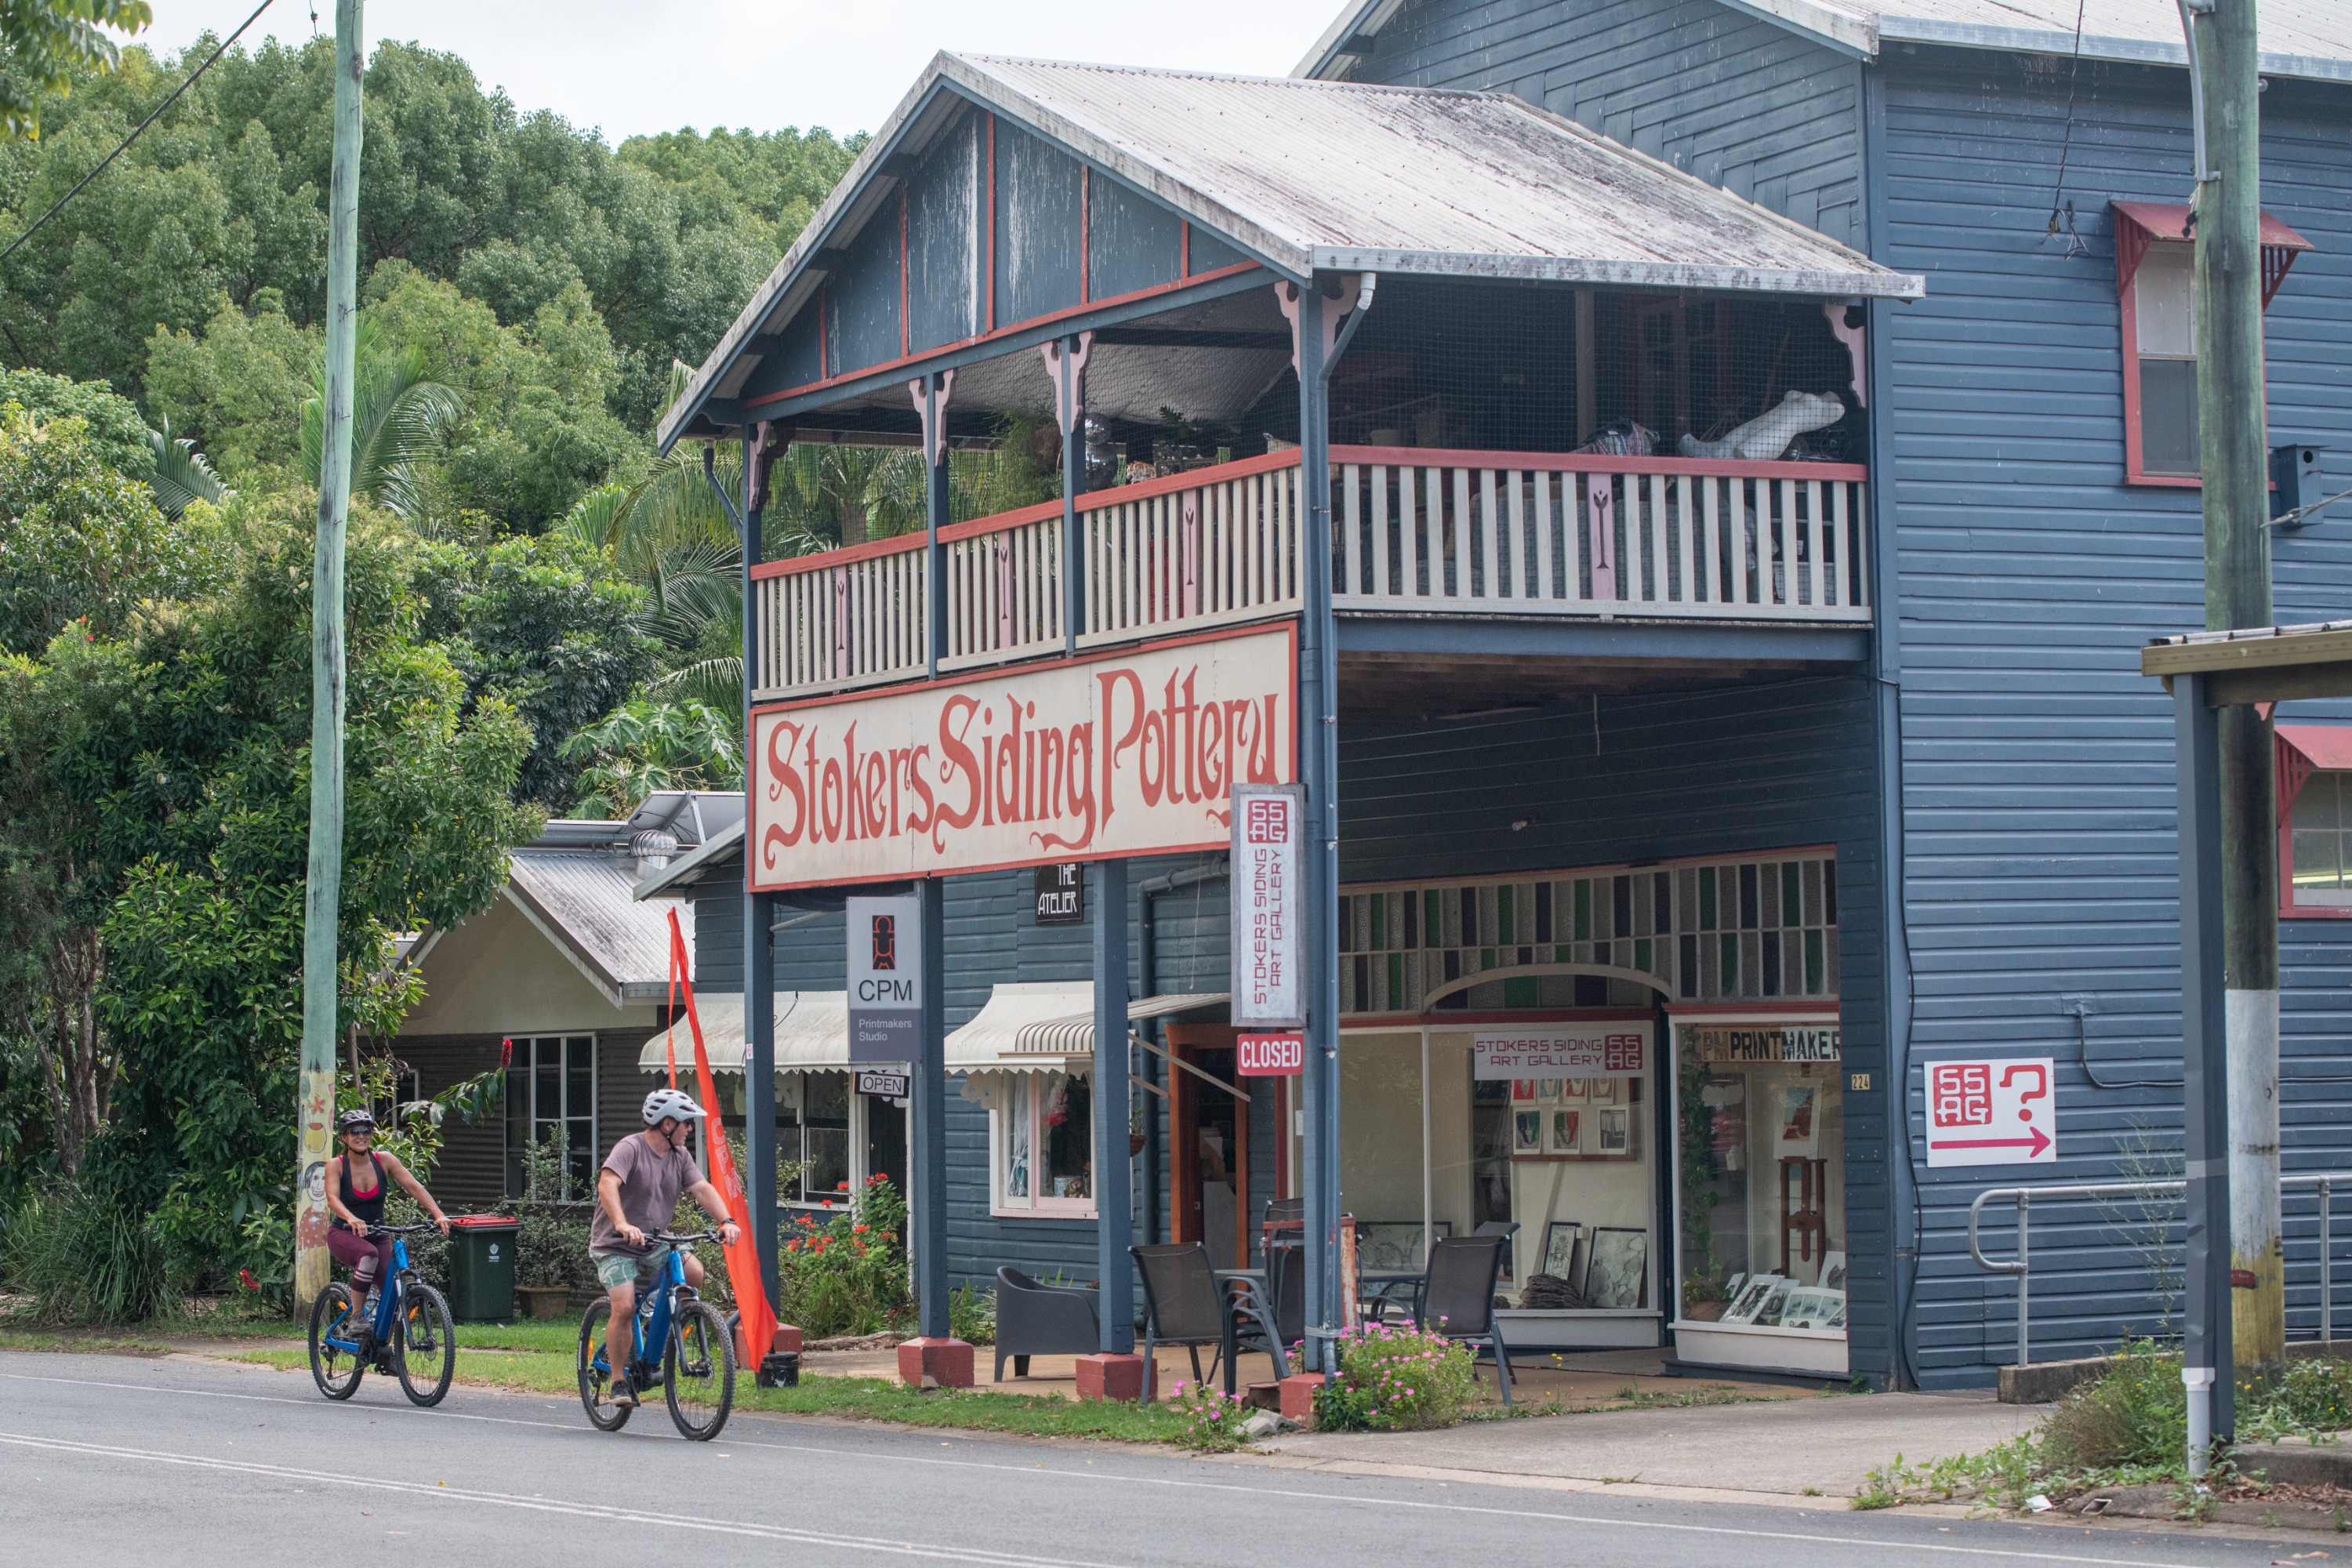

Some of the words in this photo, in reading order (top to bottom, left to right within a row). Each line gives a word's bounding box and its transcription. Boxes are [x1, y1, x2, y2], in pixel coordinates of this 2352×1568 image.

[764, 717, 935, 870] Stokers
[932, 692, 1096, 855] Siding
[1096, 663, 1279, 835] Pottery
[1056, 863, 1076, 886] THE
[1254, 848, 1267, 908] SIDING
[1037, 891, 1078, 916] ATELIER
[1270, 849, 1282, 941] GALLERY
[1254, 913, 1266, 1004] STOKERS
[1270, 949, 1281, 986] ART
[858, 980, 912, 1001] CPM
[859, 1019, 912, 1029] Printmakers
[859, 1032, 887, 1041] Studio
[1241, 1040, 1302, 1069] CLOSED
[1475, 1040, 1550, 1053] STOKERS
[1554, 1039, 1602, 1051] SIDING
[1490, 1056, 1521, 1066] ART
[1527, 1054, 1602, 1066] GALLERY
[863, 1076, 902, 1092] OPEN
[1853, 1076, 1869, 1089] 224
[1939, 1068, 1985, 1094] SS
[1936, 1095, 1989, 1123] AG
[711, 1116, 742, 1201] CPM
